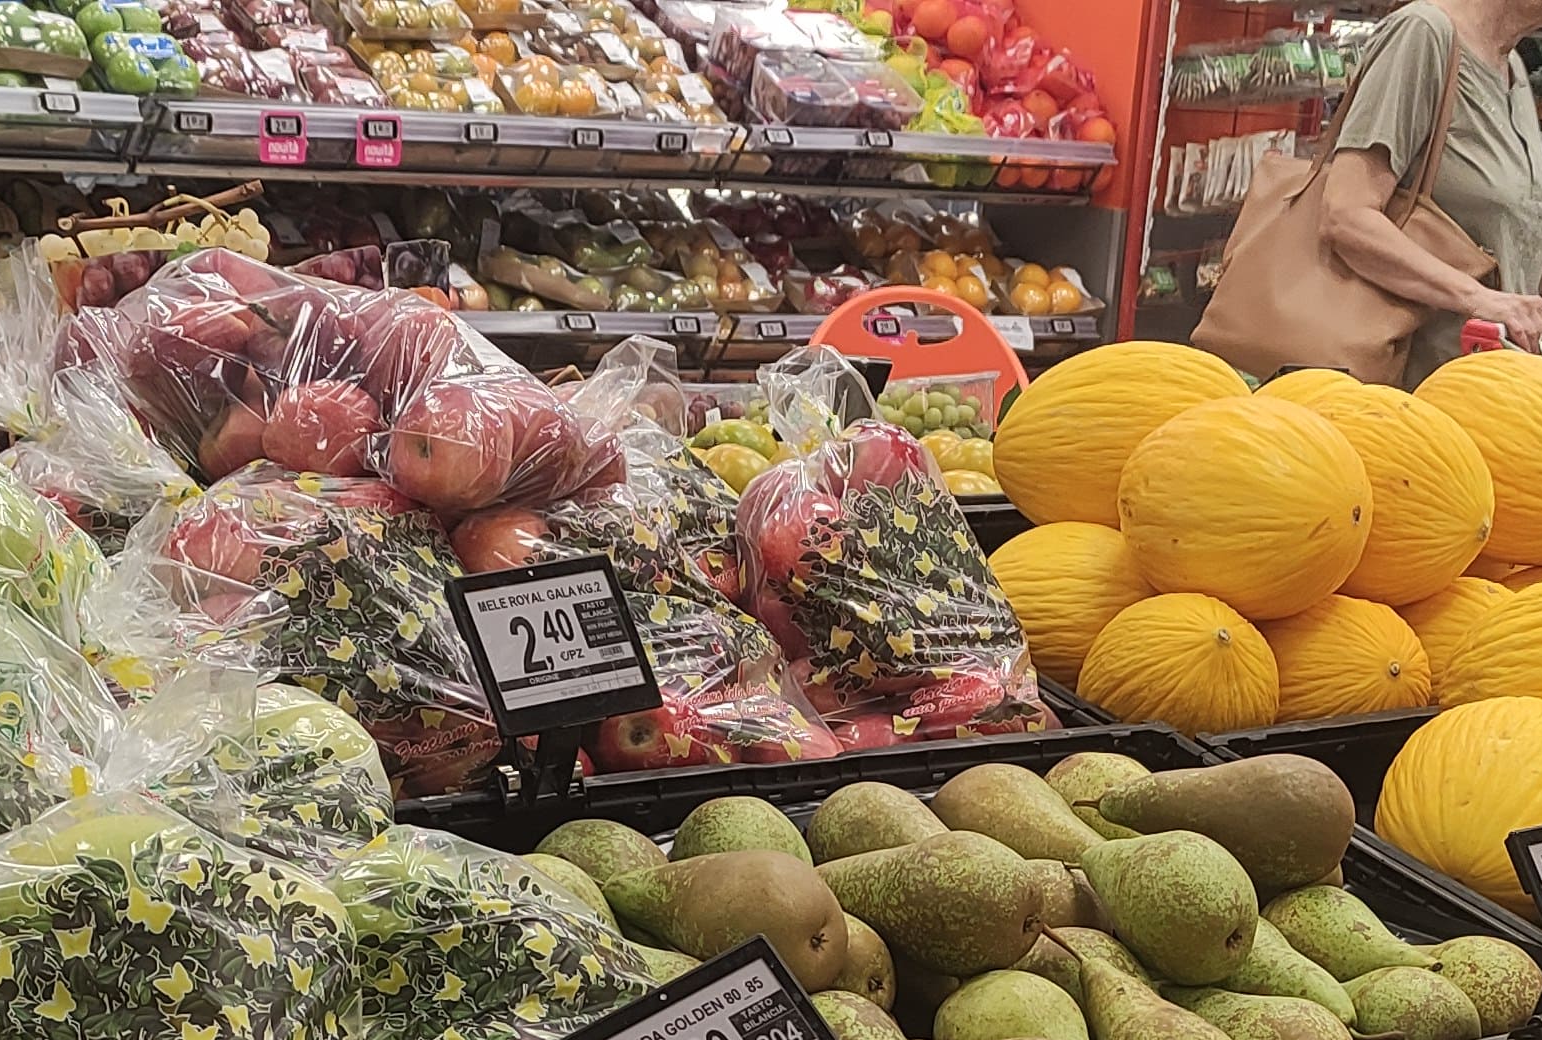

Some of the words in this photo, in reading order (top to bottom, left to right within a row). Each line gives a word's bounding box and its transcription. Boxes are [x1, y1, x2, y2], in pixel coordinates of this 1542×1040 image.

[477, 599, 509, 613] MELE
[508, 591, 546, 608] ROYAL
[547, 585, 576, 602] GALA
[577, 581, 602, 596] KG.2
[664, 1001, 725, 1037] GOLDEN
[740, 998, 774, 1019] TASTO
[742, 1003, 788, 1032] BILANCIA
